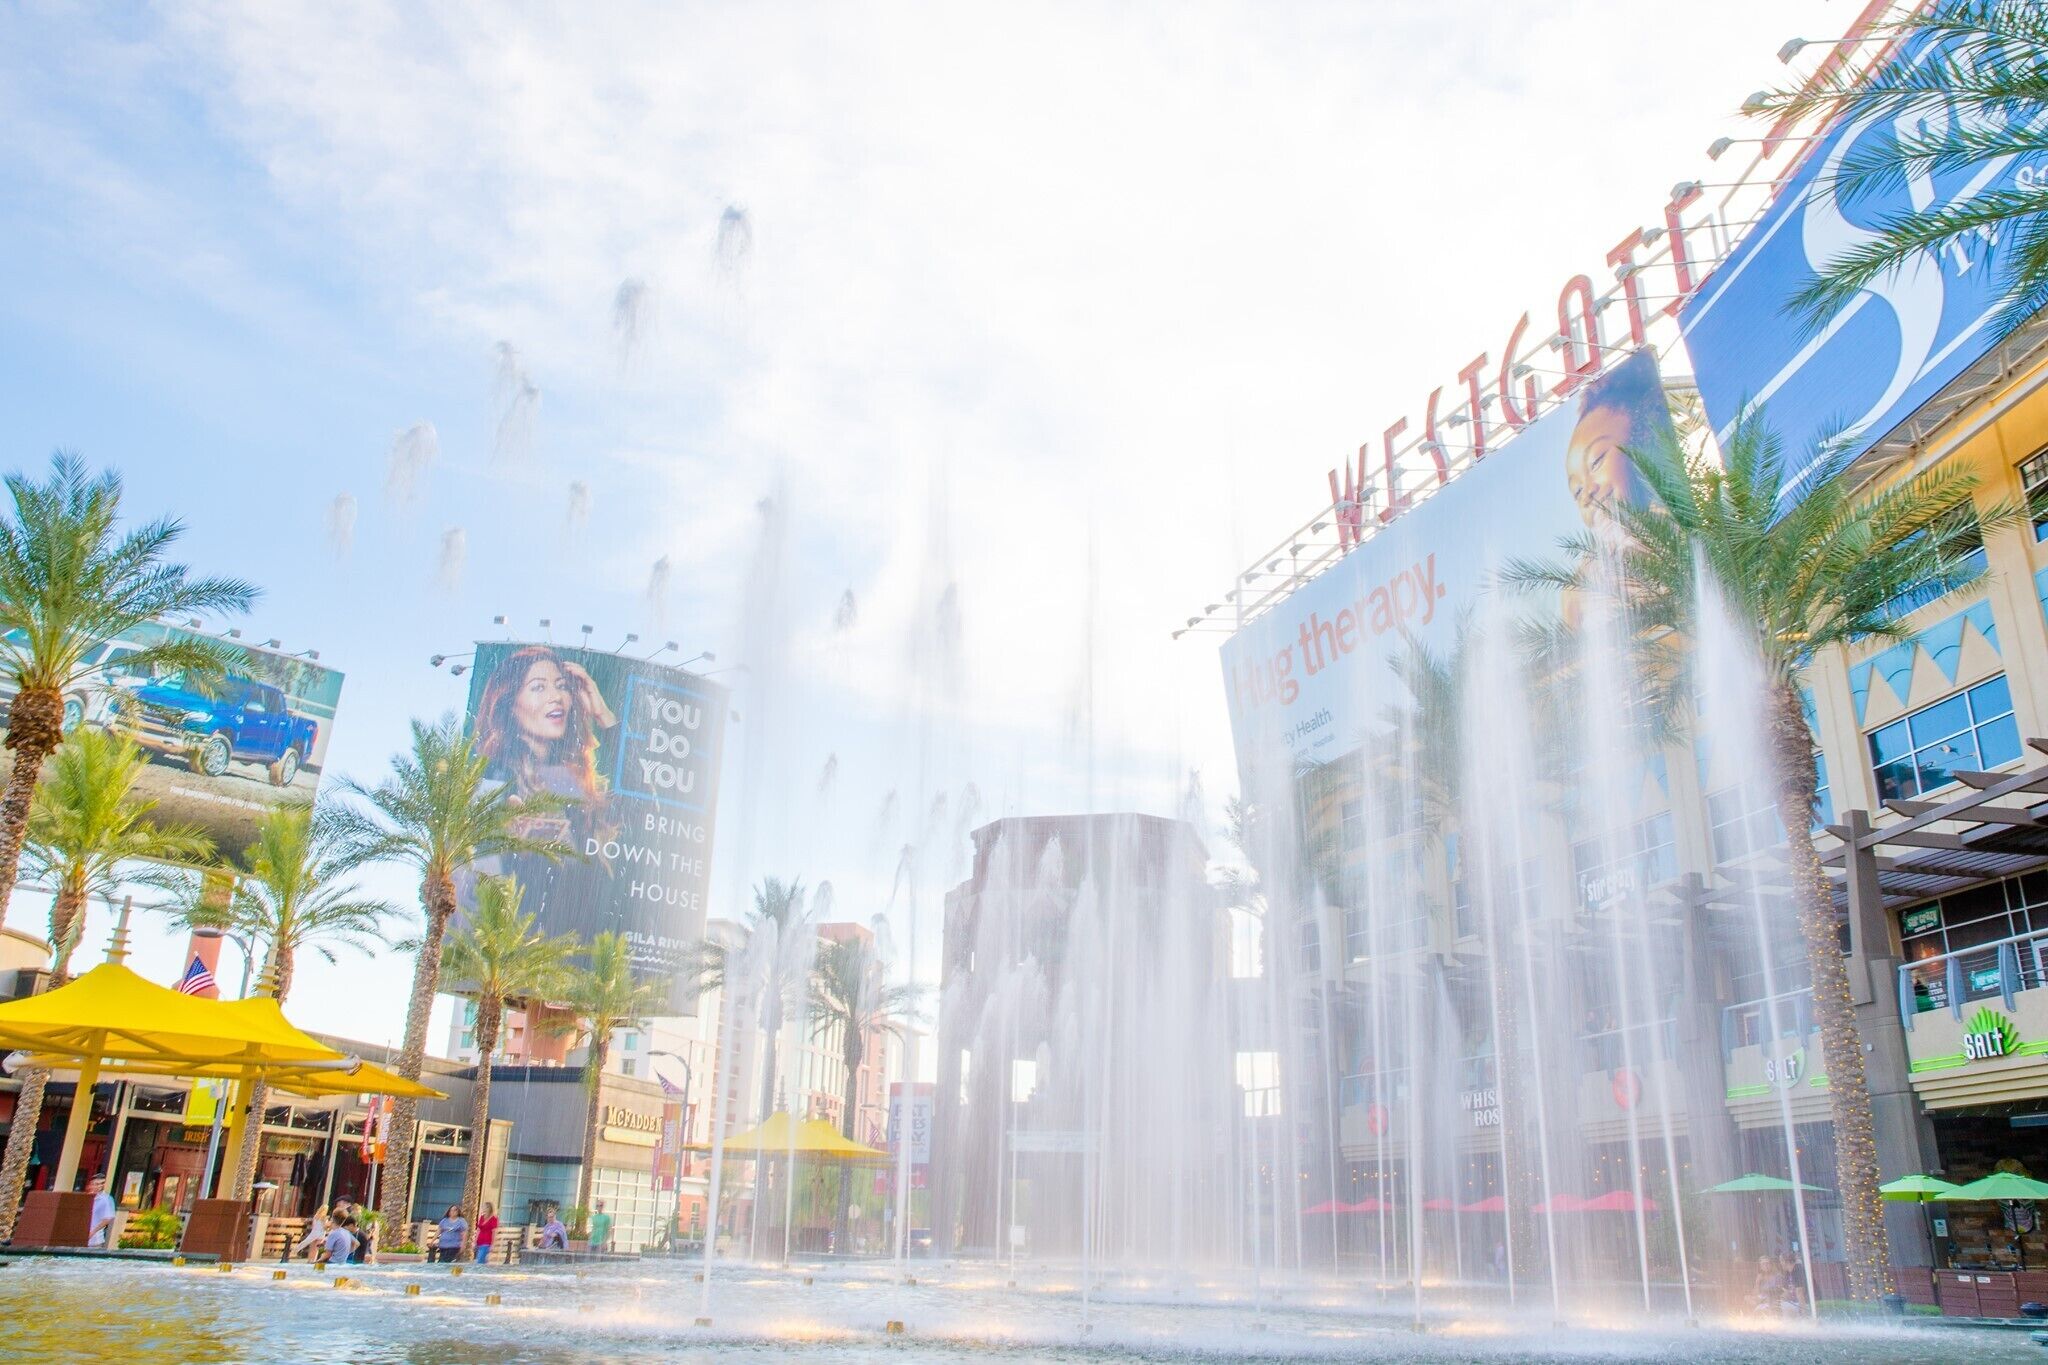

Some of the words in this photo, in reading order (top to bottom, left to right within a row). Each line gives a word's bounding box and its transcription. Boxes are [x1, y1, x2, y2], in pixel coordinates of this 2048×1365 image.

[1328, 180, 1714, 553] WESTGATE
[1232, 644, 1299, 708] Hug
[1299, 553, 1446, 676] therapy.
[647, 694, 701, 730] YOU
[1296, 707, 1332, 737] Health
[649, 728, 690, 759] DO
[639, 758, 695, 793] YOU
[645, 813, 705, 843] BRING
[585, 838, 662, 867] DOWN
[671, 853, 703, 877] THE
[630, 880, 700, 910] HOUSE
[625, 931, 655, 947] GILA
[1461, 1090, 1496, 1110] WHIS
[1475, 1108, 1500, 1127] ROS
